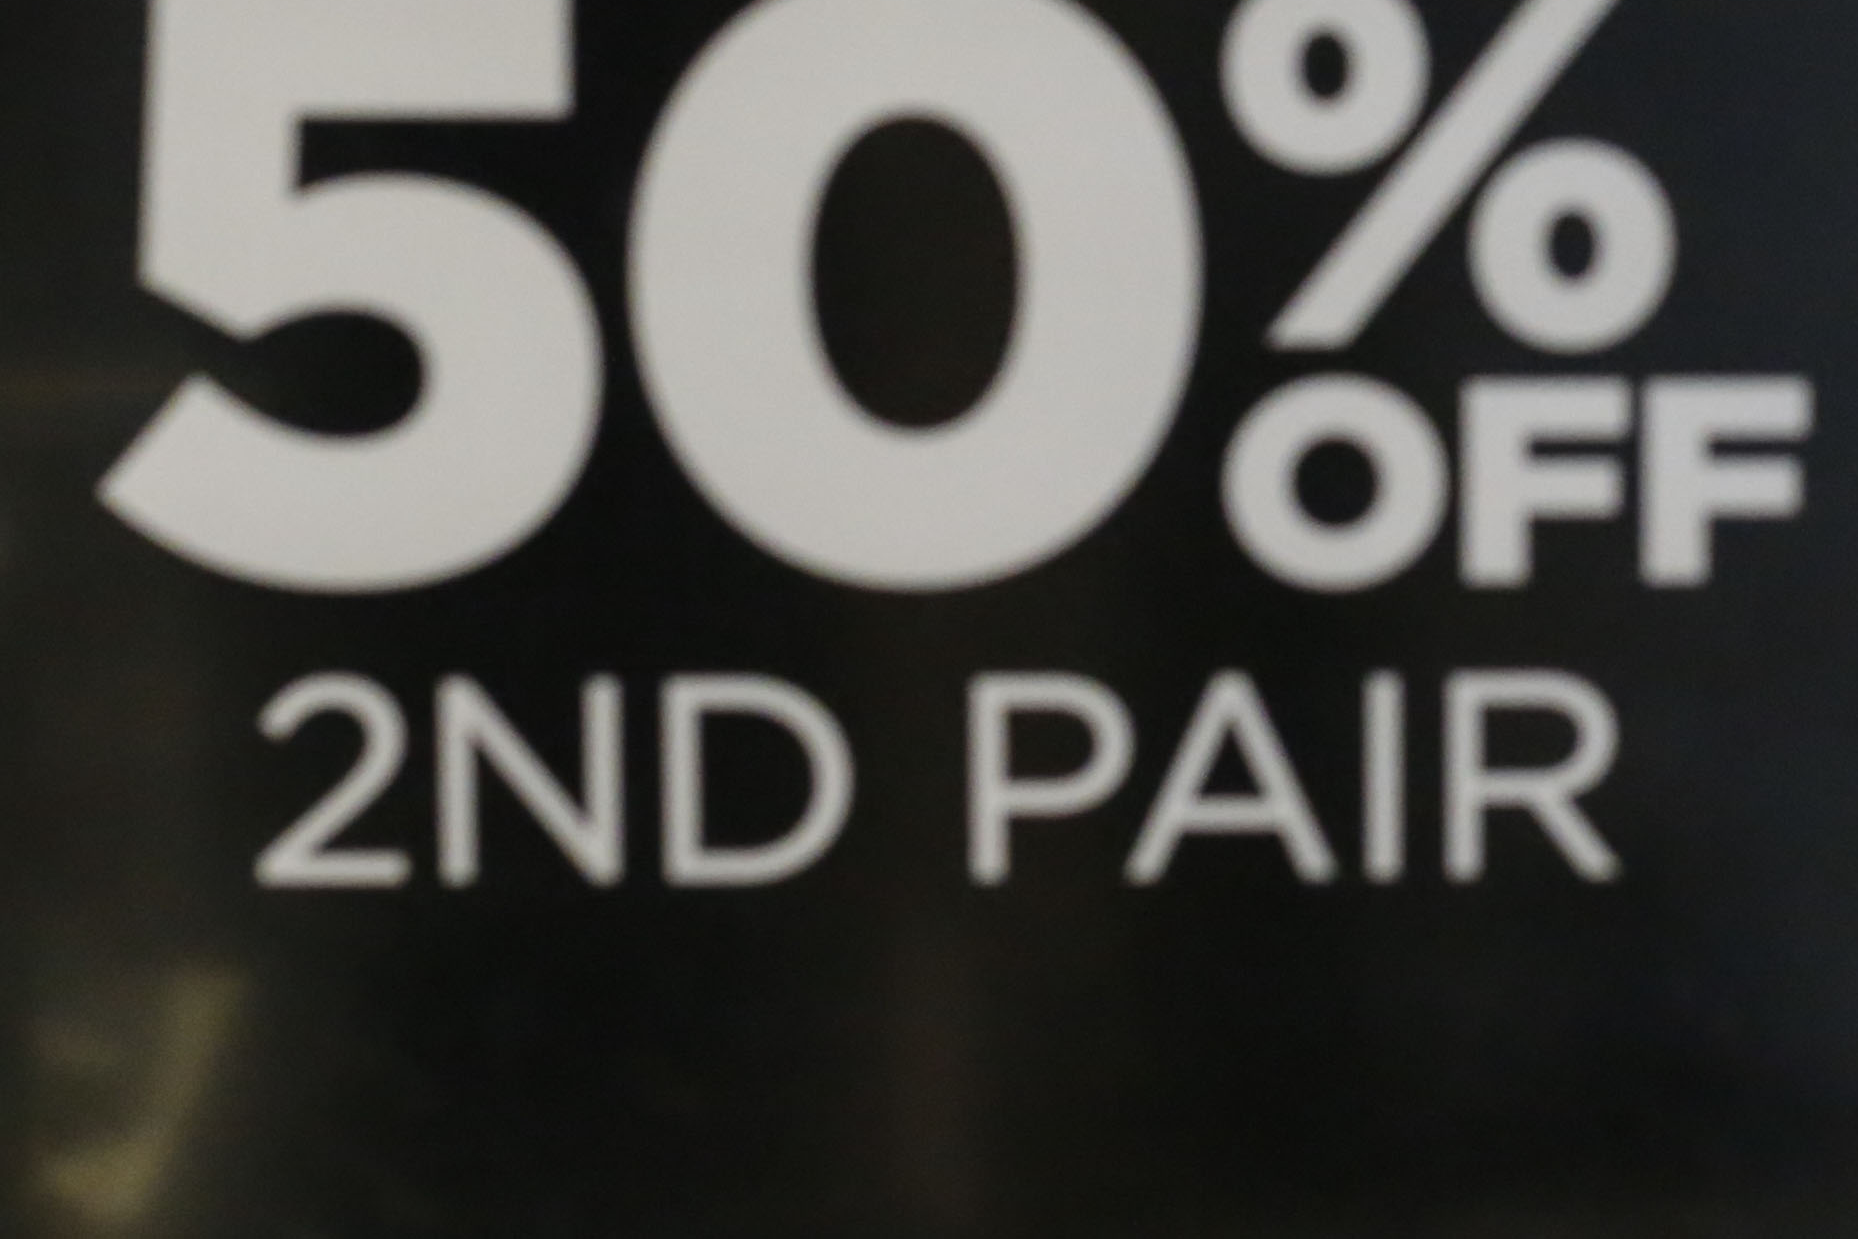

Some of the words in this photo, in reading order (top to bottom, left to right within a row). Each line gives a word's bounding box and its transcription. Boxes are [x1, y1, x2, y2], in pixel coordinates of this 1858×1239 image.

[1221, 373, 1815, 592] OFF
[253, 672, 855, 889] 2ND
[966, 668, 1620, 884] PAIR
